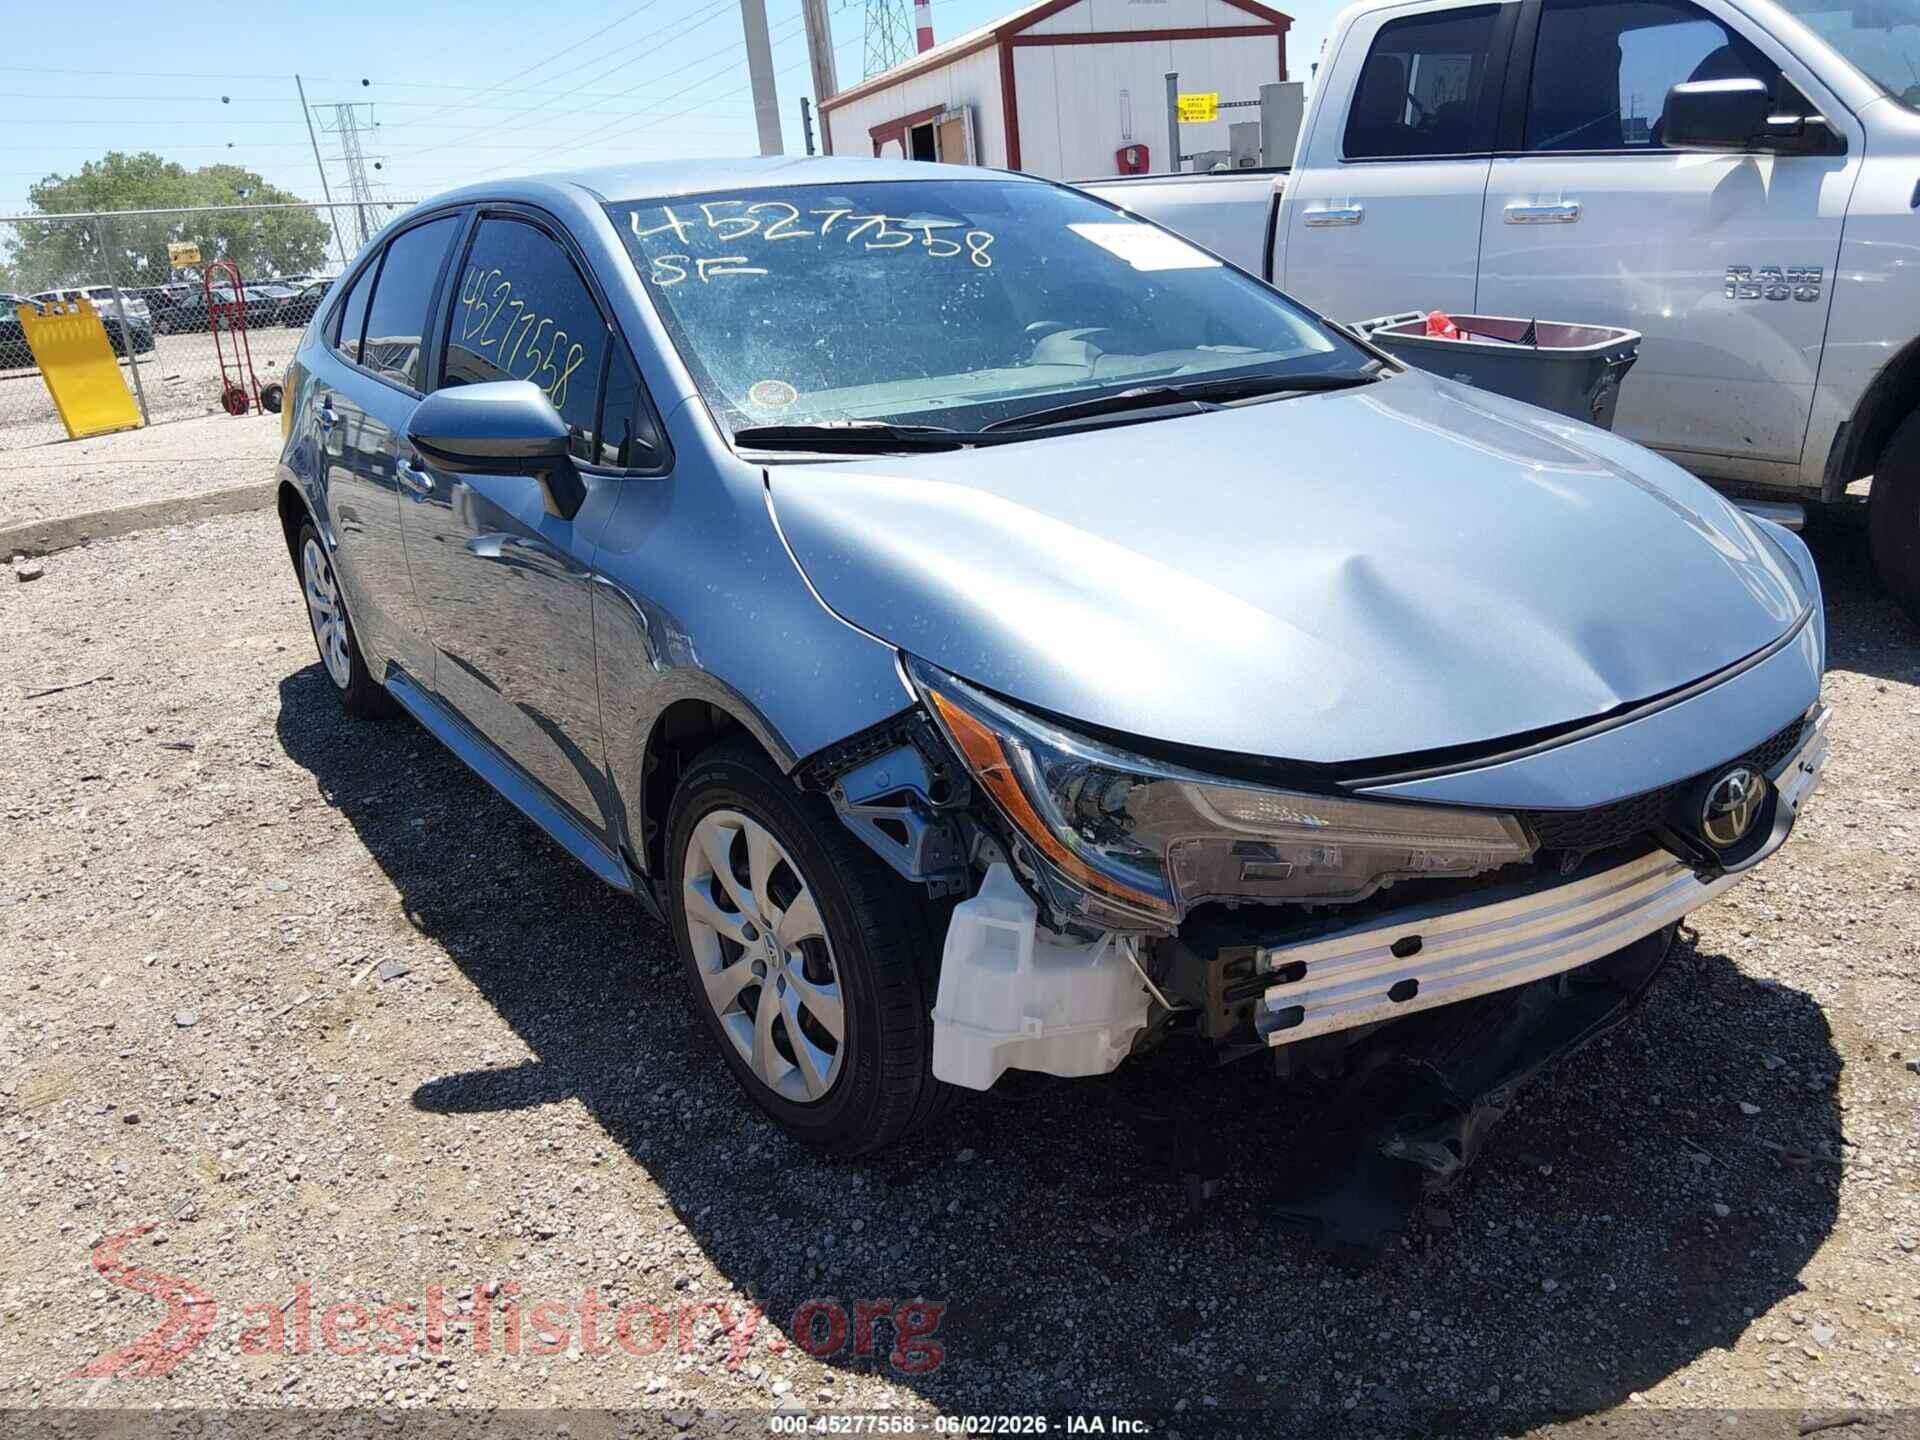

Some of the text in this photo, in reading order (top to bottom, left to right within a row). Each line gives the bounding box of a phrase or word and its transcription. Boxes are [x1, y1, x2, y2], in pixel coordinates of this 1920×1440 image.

[630, 200, 994, 267] 45277558
[1725, 265, 1823, 283] RAM
[1725, 283, 1821, 302] 1500
[462, 266, 584, 409] 45277558
